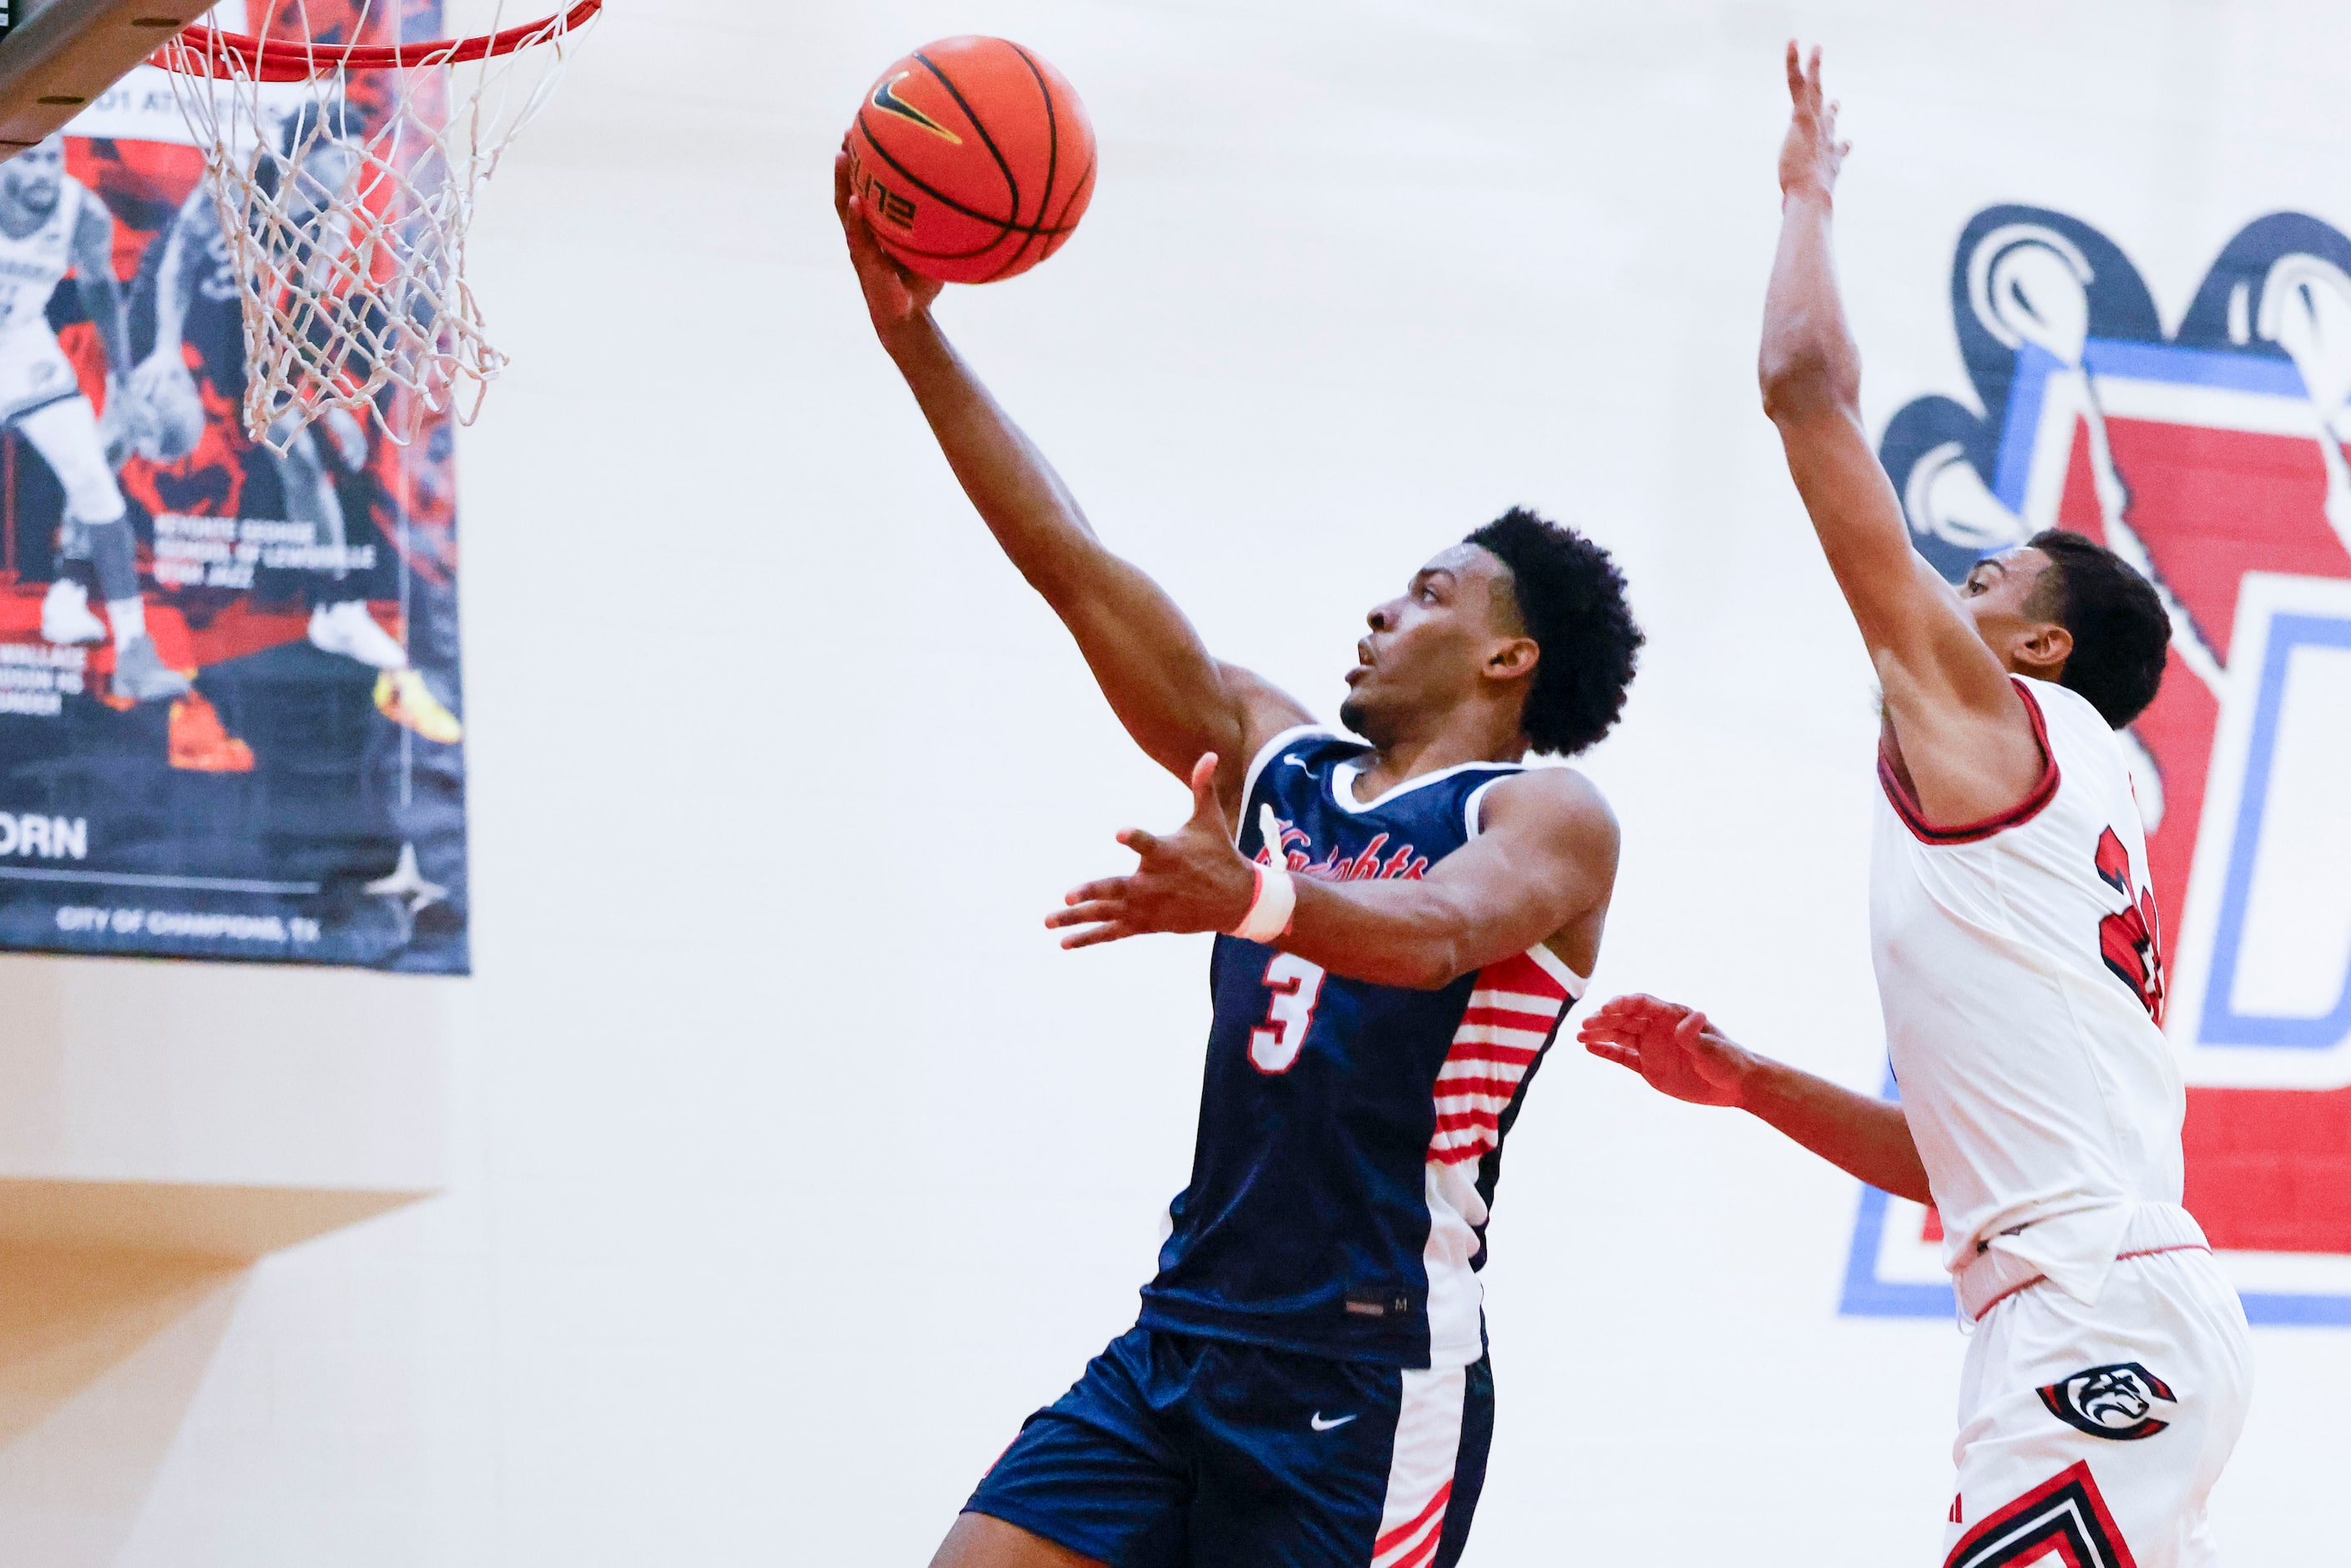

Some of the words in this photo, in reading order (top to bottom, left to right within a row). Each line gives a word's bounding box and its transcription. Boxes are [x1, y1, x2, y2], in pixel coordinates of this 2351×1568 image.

[56, 905, 109, 932] CITY
[110, 908, 144, 934] OF
[1246, 950, 1327, 1075] 3
